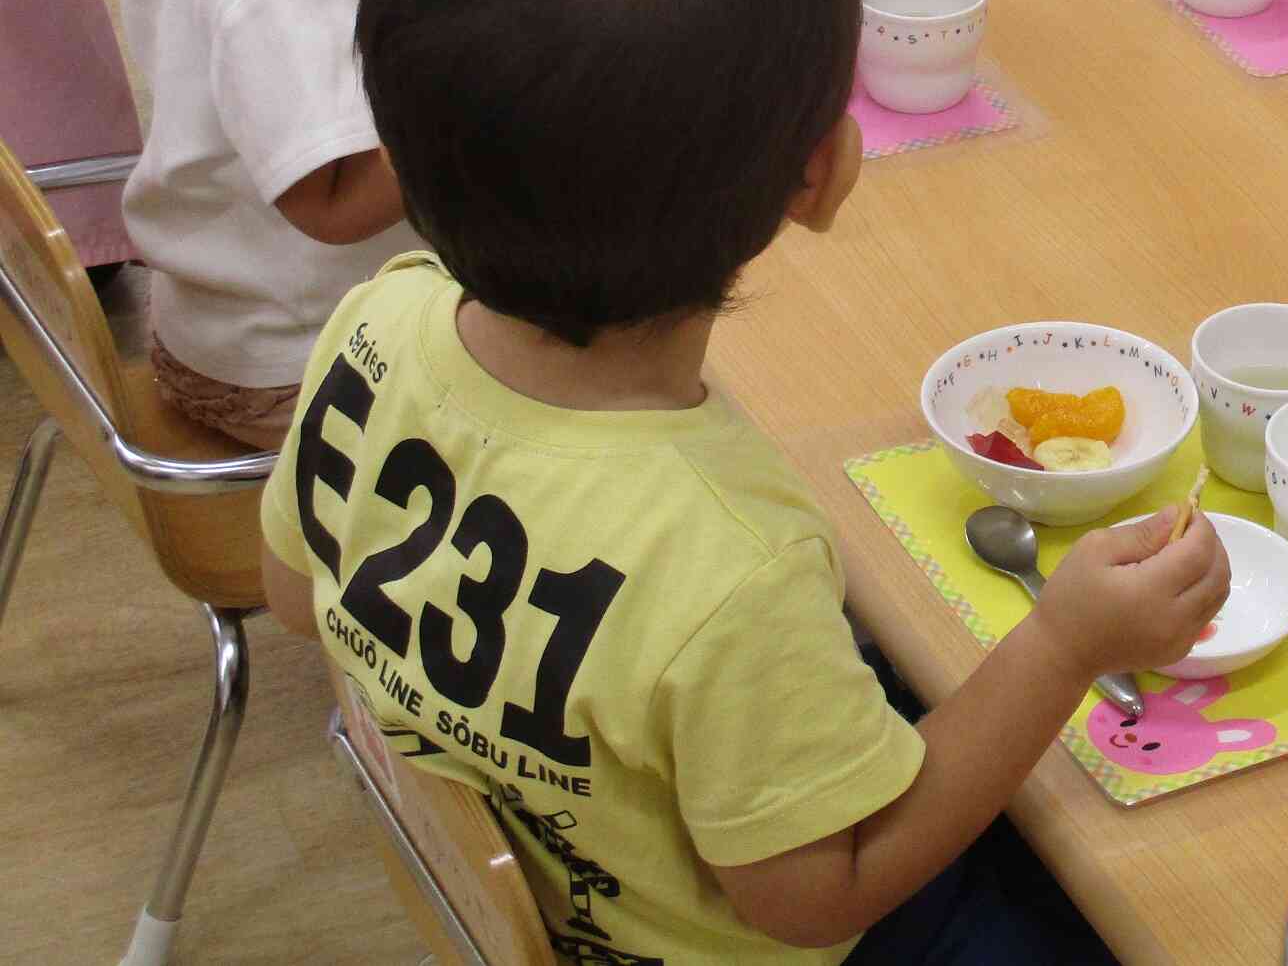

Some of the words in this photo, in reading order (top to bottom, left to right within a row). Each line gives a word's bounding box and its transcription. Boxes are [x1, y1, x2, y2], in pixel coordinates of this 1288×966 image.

[907, 34, 918, 45] S
[349, 322, 388, 384] Series
[987, 349, 998, 362] H
[1014, 334, 1024, 347] I
[1042, 332, 1053, 345] J
[1074, 337, 1085, 349] K
[1128, 346, 1141, 359] M
[1153, 364, 1163, 378] N
[1209, 385, 1219, 400] V
[296, 352, 627, 767] E231
[378, 659, 424, 718] LINE
[517, 755, 592, 797] LINE
